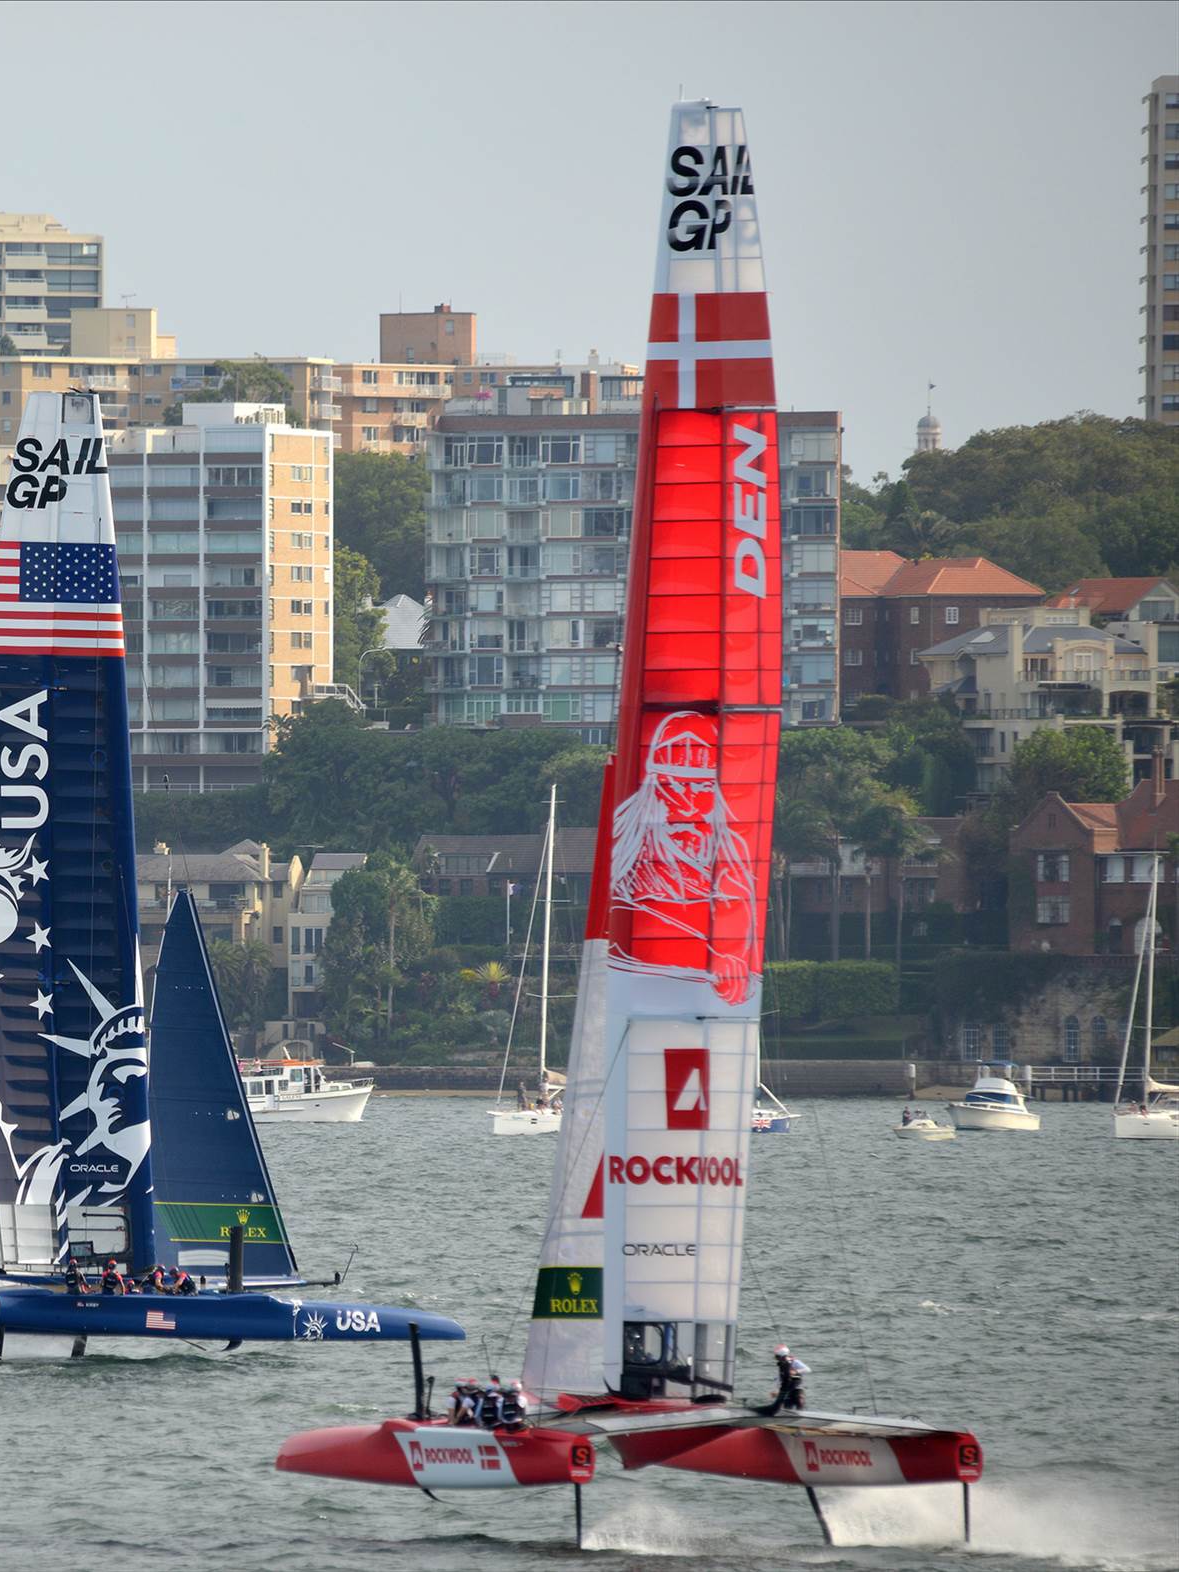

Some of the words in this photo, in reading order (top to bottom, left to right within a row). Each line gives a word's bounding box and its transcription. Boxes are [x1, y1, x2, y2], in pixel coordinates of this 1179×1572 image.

[667, 146, 754, 197] SAIL
[667, 200, 731, 252] GP
[13, 437, 108, 474] SAIL
[6, 475, 67, 509] GP
[733, 423, 767, 598] DEN
[0, 689, 49, 829] USA
[69, 1164, 119, 1173] ORACLE
[220, 1226, 267, 1238] REX
[622, 1243, 698, 1257] ORACLE
[550, 1298, 599, 1313] ROLEX
[336, 1310, 381, 1332] USA
[424, 1447, 474, 1465] ROCKWOOL
[820, 1449, 873, 1467] ROCKWOOL
